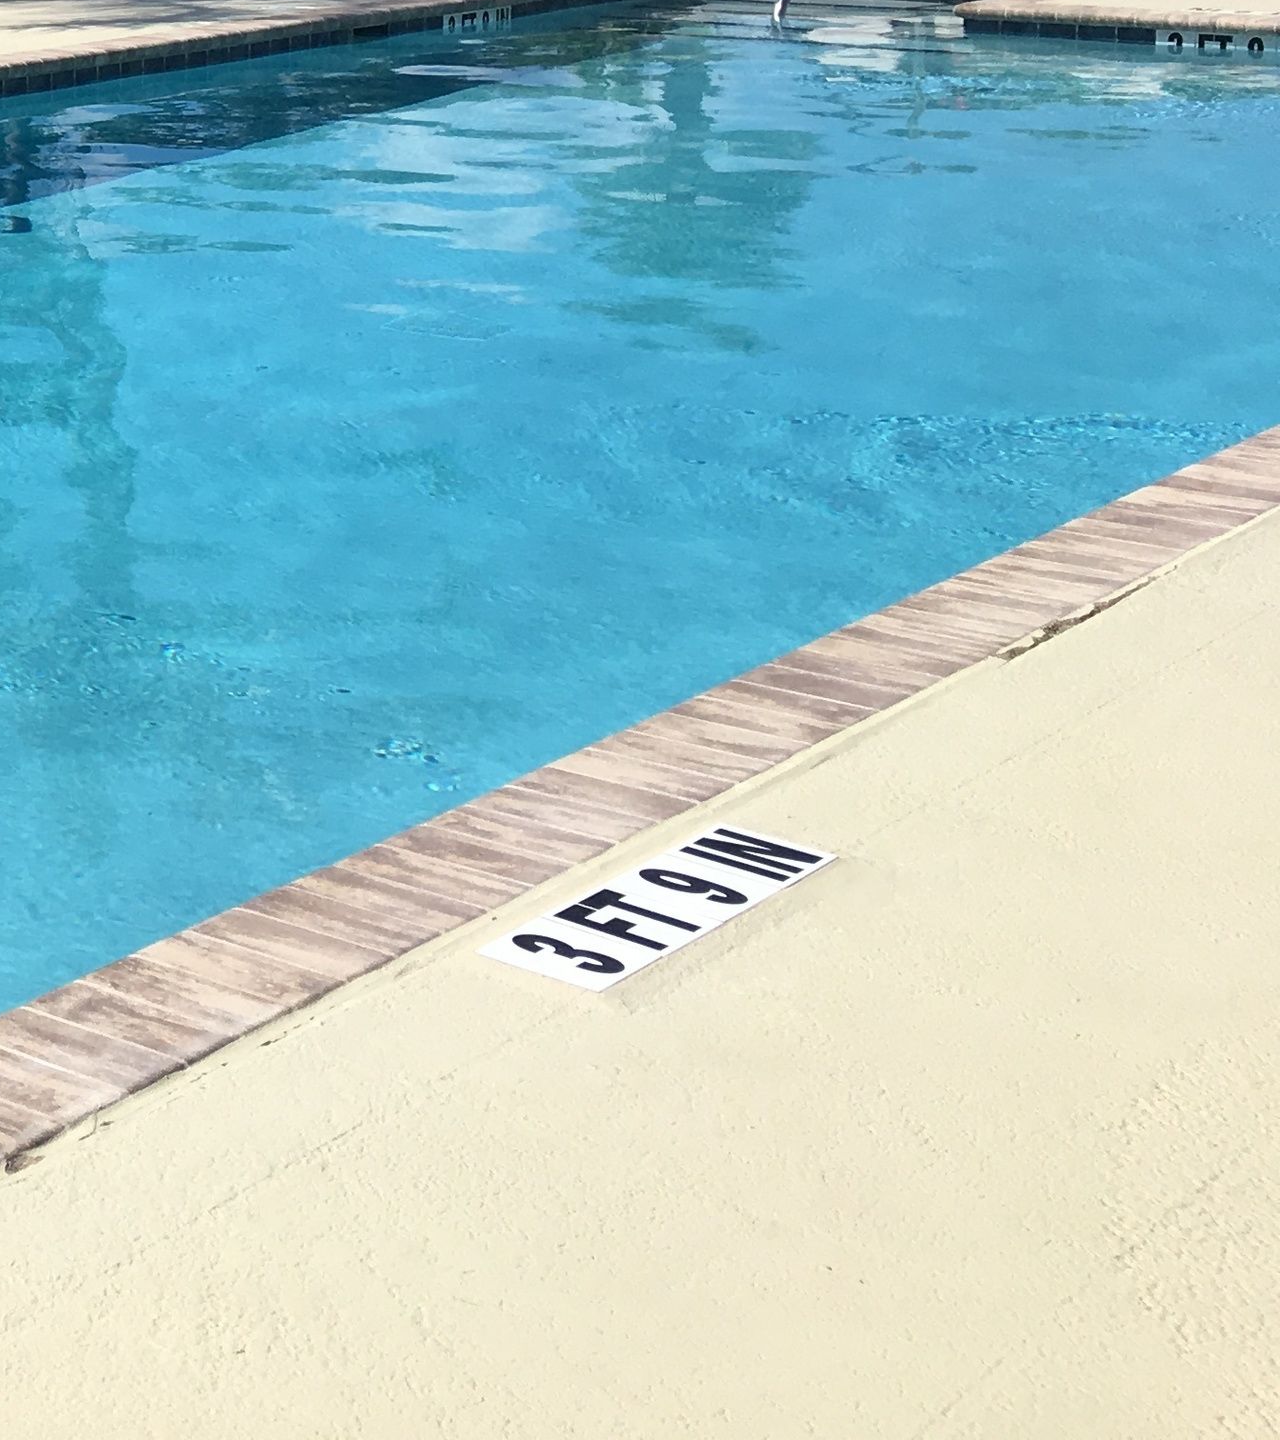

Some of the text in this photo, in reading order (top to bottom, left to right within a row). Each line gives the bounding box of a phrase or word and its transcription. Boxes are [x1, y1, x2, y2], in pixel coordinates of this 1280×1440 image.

[512, 828, 824, 974] 3 FT 9 IN
